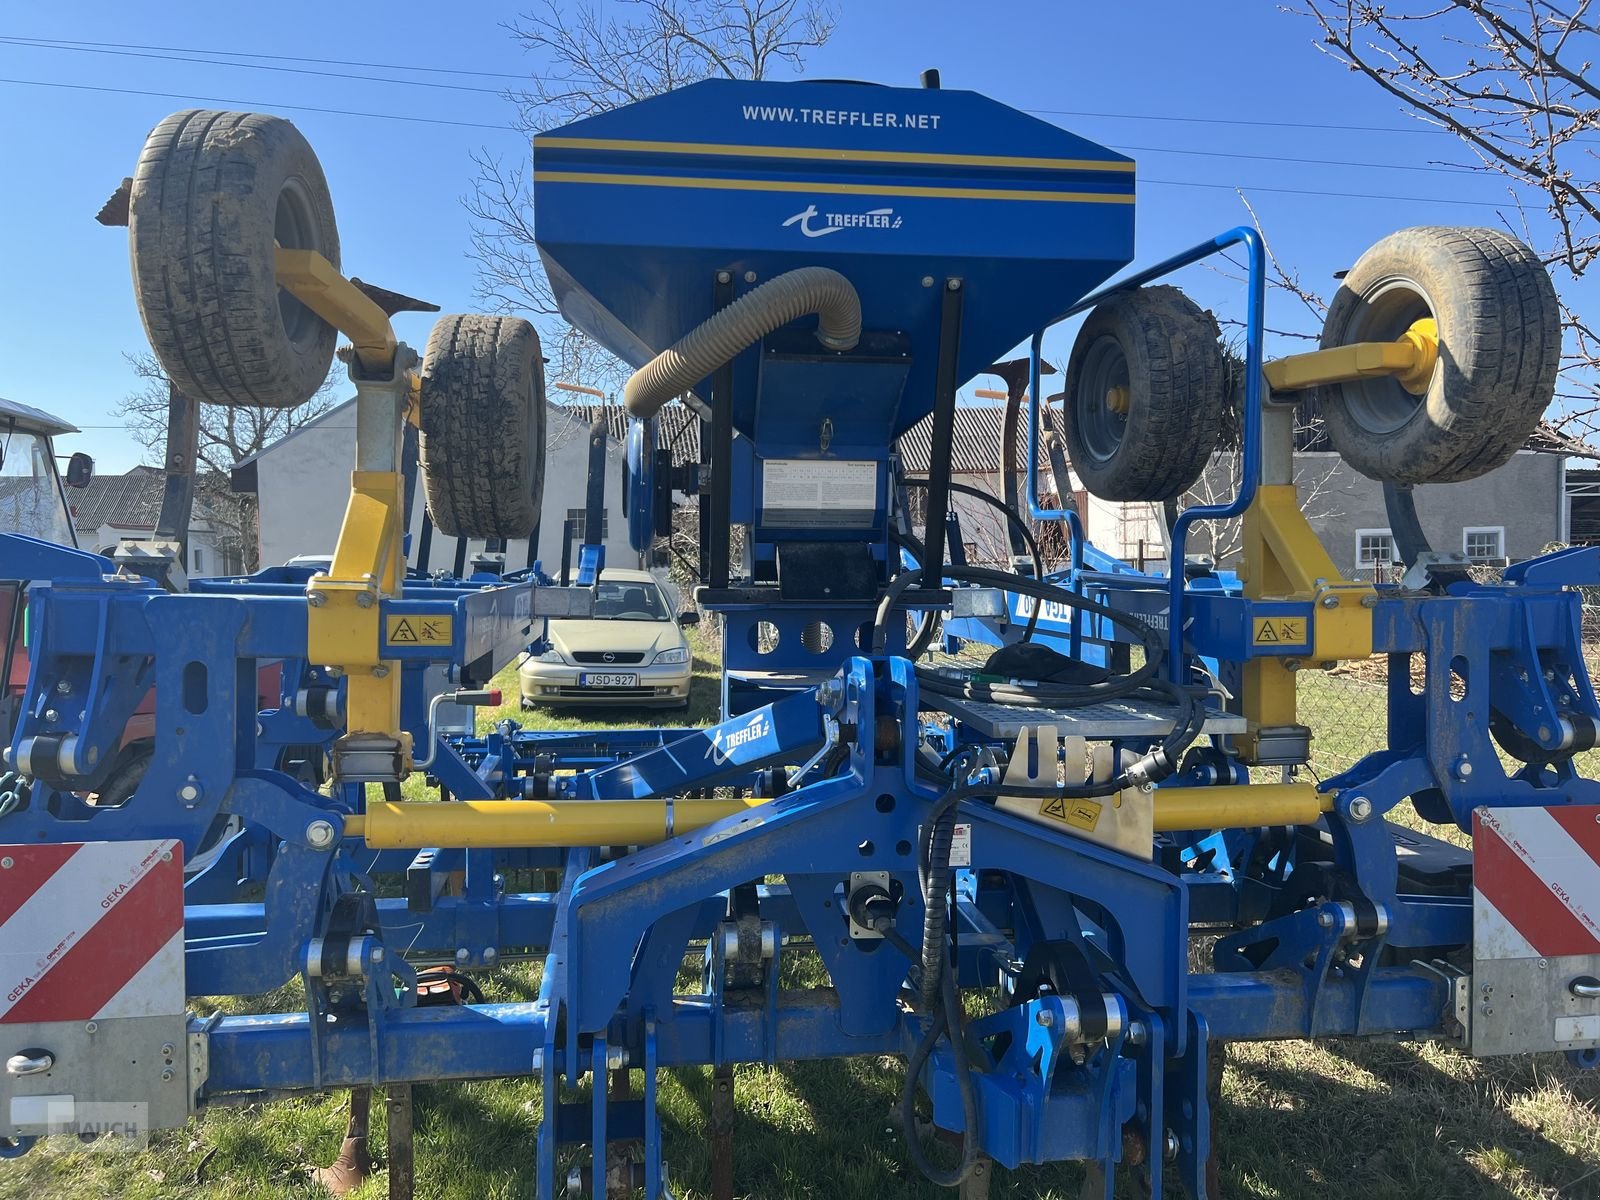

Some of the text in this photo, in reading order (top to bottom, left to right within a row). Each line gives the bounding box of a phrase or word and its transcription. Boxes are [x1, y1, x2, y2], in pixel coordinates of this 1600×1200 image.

[743, 105, 941, 129] WWW.TREFFLER.NET
[588, 675, 634, 685] JSD-927
[101, 883, 128, 909] GEKA
[1551, 882, 1570, 904] GEKA
[7, 977, 34, 1003] GEKA
